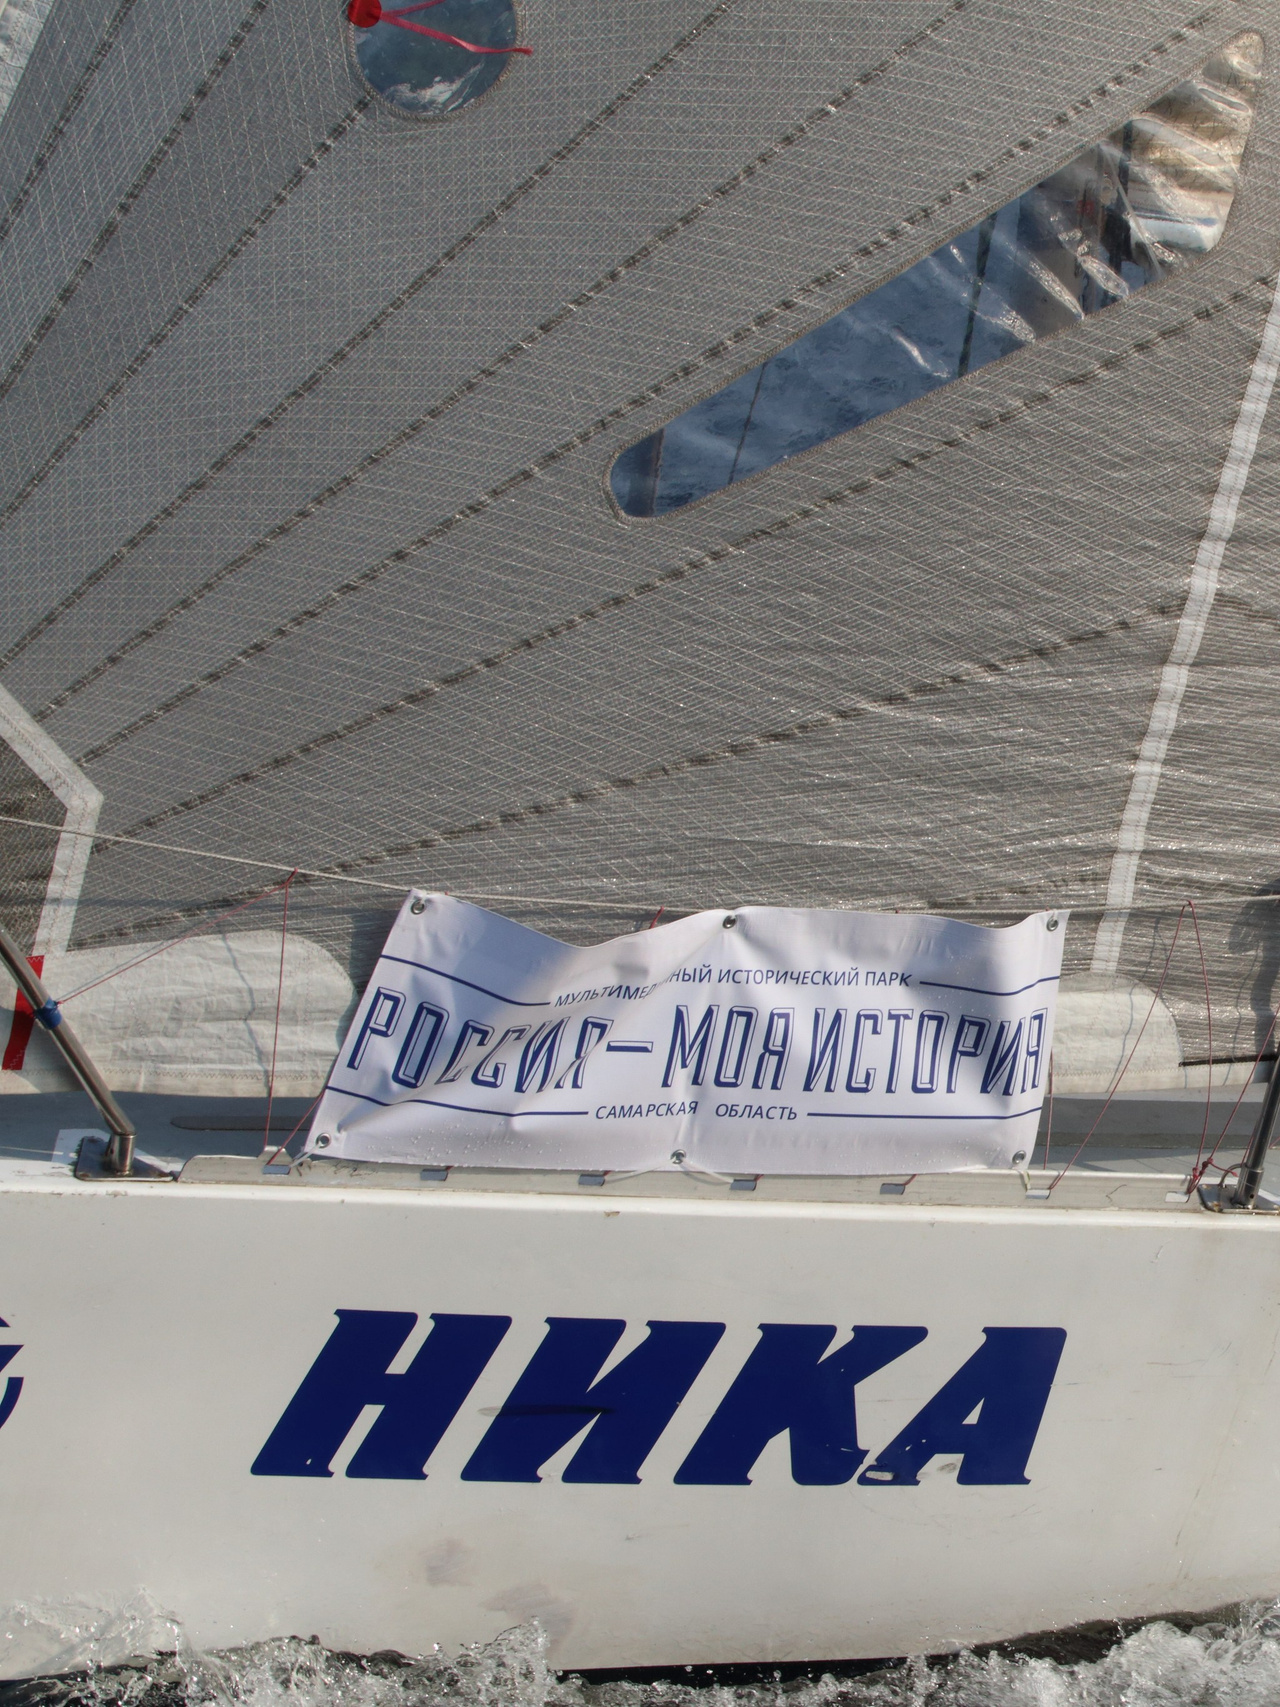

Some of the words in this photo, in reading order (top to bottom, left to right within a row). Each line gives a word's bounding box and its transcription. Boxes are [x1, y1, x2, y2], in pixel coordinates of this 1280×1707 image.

[554, 963, 713, 1008] МУЛЬТИМЕДНЫЙ
[717, 966, 861, 987] ИСТОРИЧЕСКИЙ
[864, 970, 914, 988] ПАРК
[346, 985, 615, 1094] РОССИЯ
[660, 1003, 796, 1091] МОЯ
[802, 1007, 1049, 1097] ИСТОРИЯ
[594, 1100, 699, 1120] САМАРСКАЯ
[714, 1103, 798, 1121] ОБЛАСТЬ
[250, 1309, 1068, 1487] НИКА
